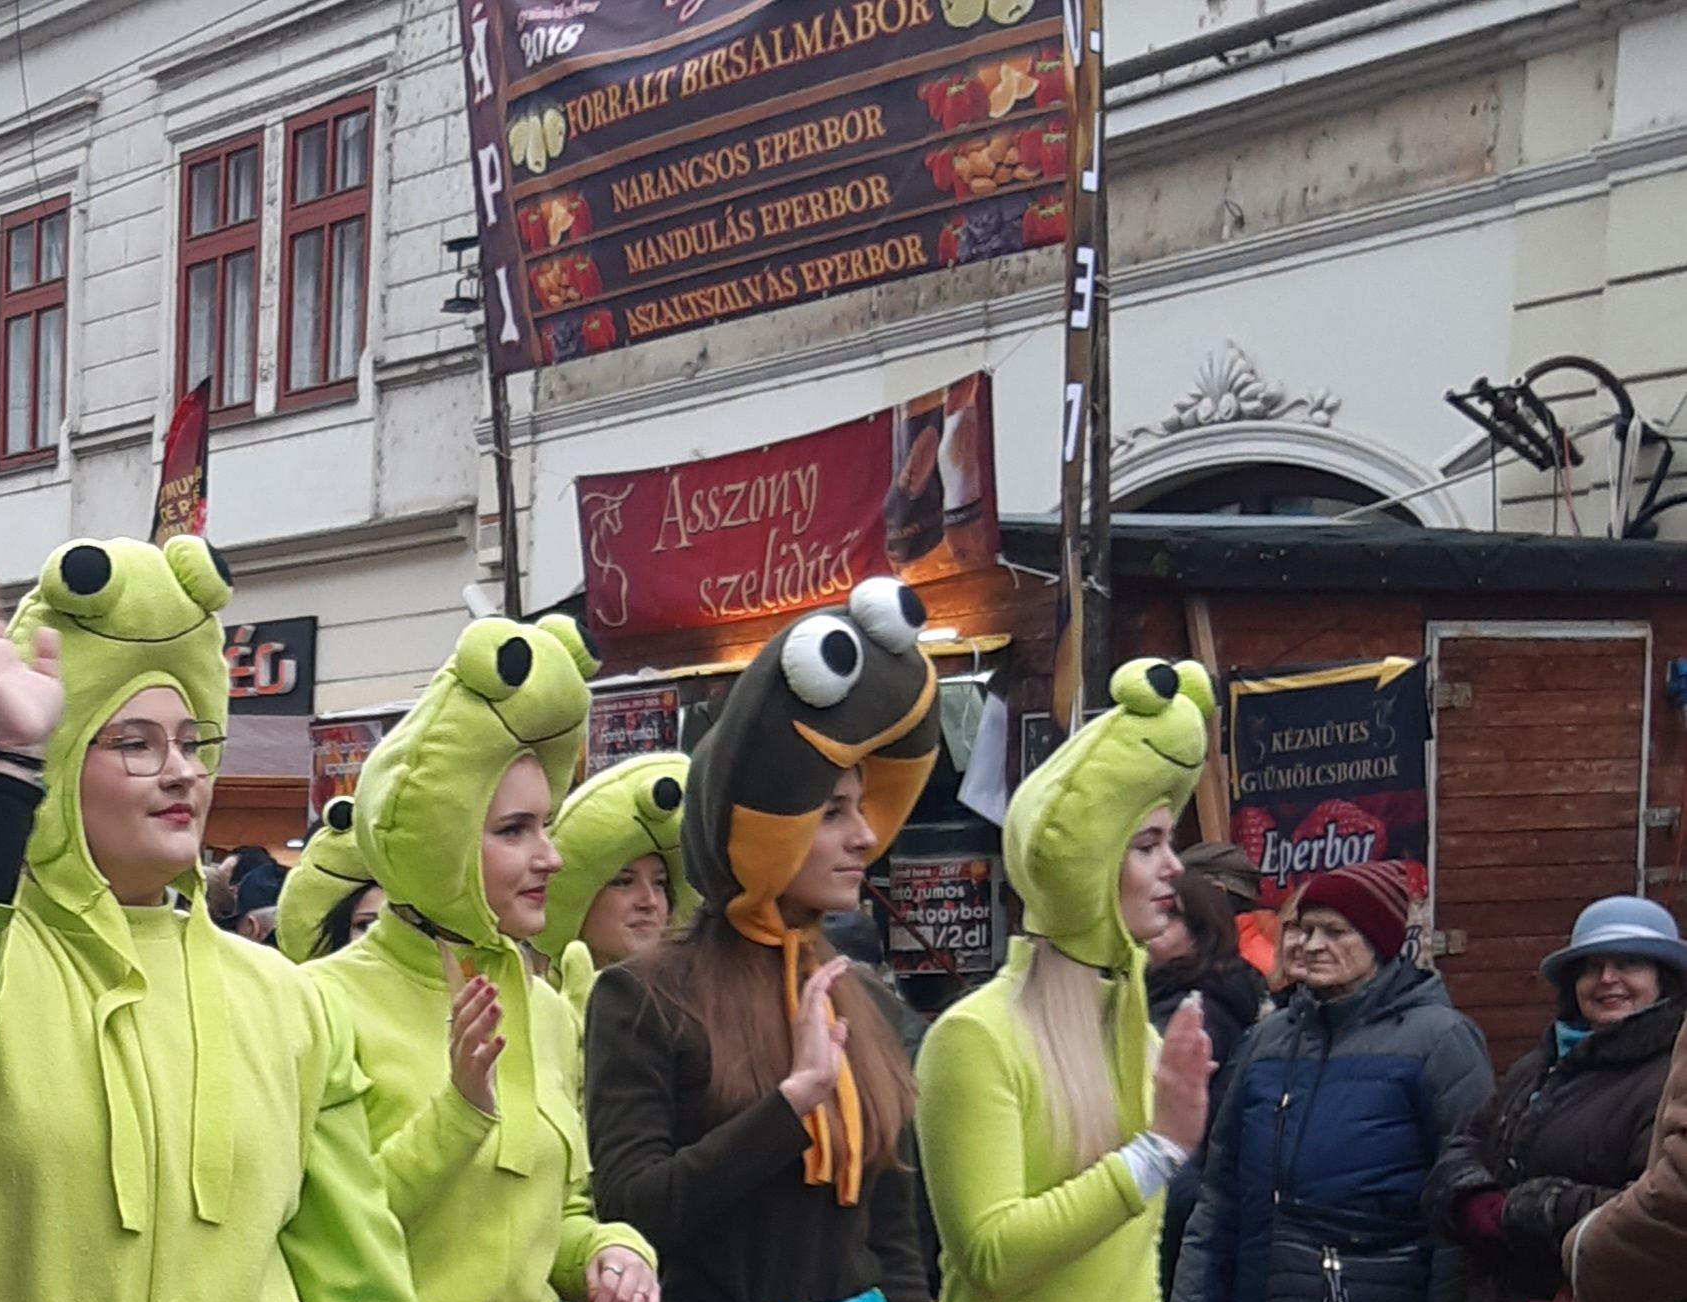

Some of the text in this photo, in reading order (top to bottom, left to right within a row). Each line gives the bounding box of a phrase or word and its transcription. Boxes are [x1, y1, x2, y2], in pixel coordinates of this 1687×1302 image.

[565, 0, 933, 139] FORRALT BIRSALMABOR
[610, 103, 886, 213] NARANCSOS EPERBOR
[624, 173, 891, 275] MANDULÁS EPERBOR
[625, 233, 928, 336] ASZALTSZILVÁS EPERBOR
[651, 463, 819, 552] Asszony
[1260, 821, 1376, 888] Eperbor
